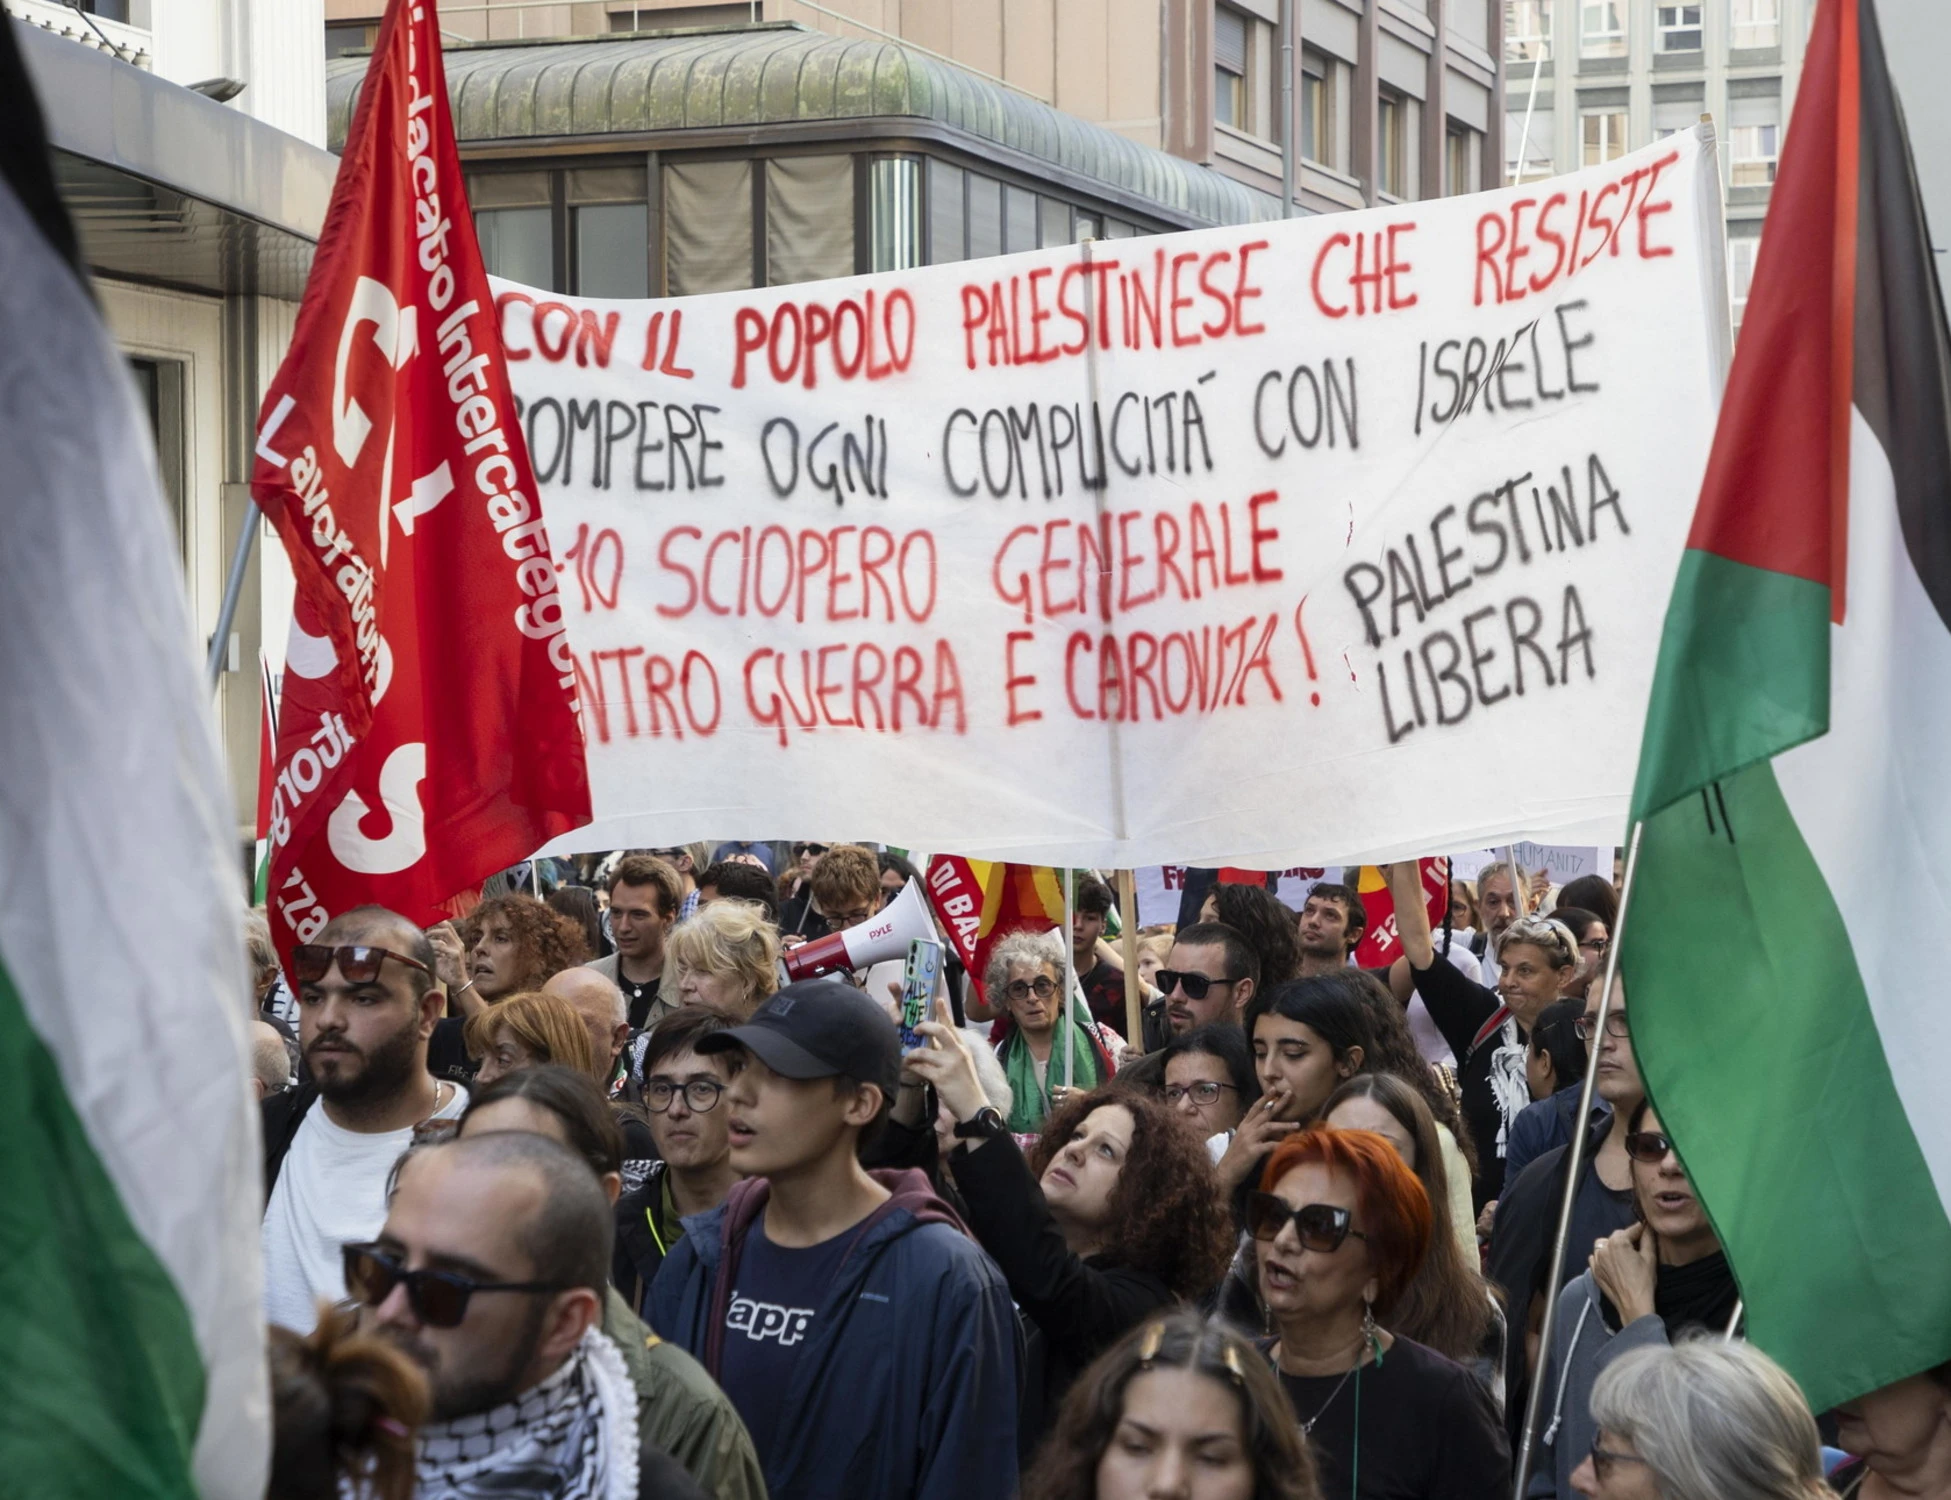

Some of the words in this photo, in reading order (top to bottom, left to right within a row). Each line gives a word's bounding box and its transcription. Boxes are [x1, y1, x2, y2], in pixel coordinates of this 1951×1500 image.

[497, 292, 620, 368] CON
[641, 310, 694, 380] IL
[731, 288, 916, 389] POPOLO
[961, 240, 1269, 370] PALESTINESE
[1310, 223, 1418, 318] CHE
[1475, 151, 1679, 306] RESISTE
[513, 394, 726, 491] OMPERE
[761, 414, 888, 506] OGNI
[1254, 357, 1359, 458] CON
[1414, 299, 1600, 436] ISRAELE
[655, 525, 937, 623] SCIOPERO
[992, 490, 1283, 627] GENERALE
[1343, 453, 1631, 648] PALESTINA
[571, 646, 721, 745] NTRO
[743, 638, 967, 747] GUERRA
[1005, 631, 1043, 726] E
[1377, 584, 1596, 744] LIBERA
[869, 923, 892, 940] PYLE
[930, 860, 962, 897] DI
[943, 893, 980, 960] BAS
[727, 1291, 815, 1346] app
